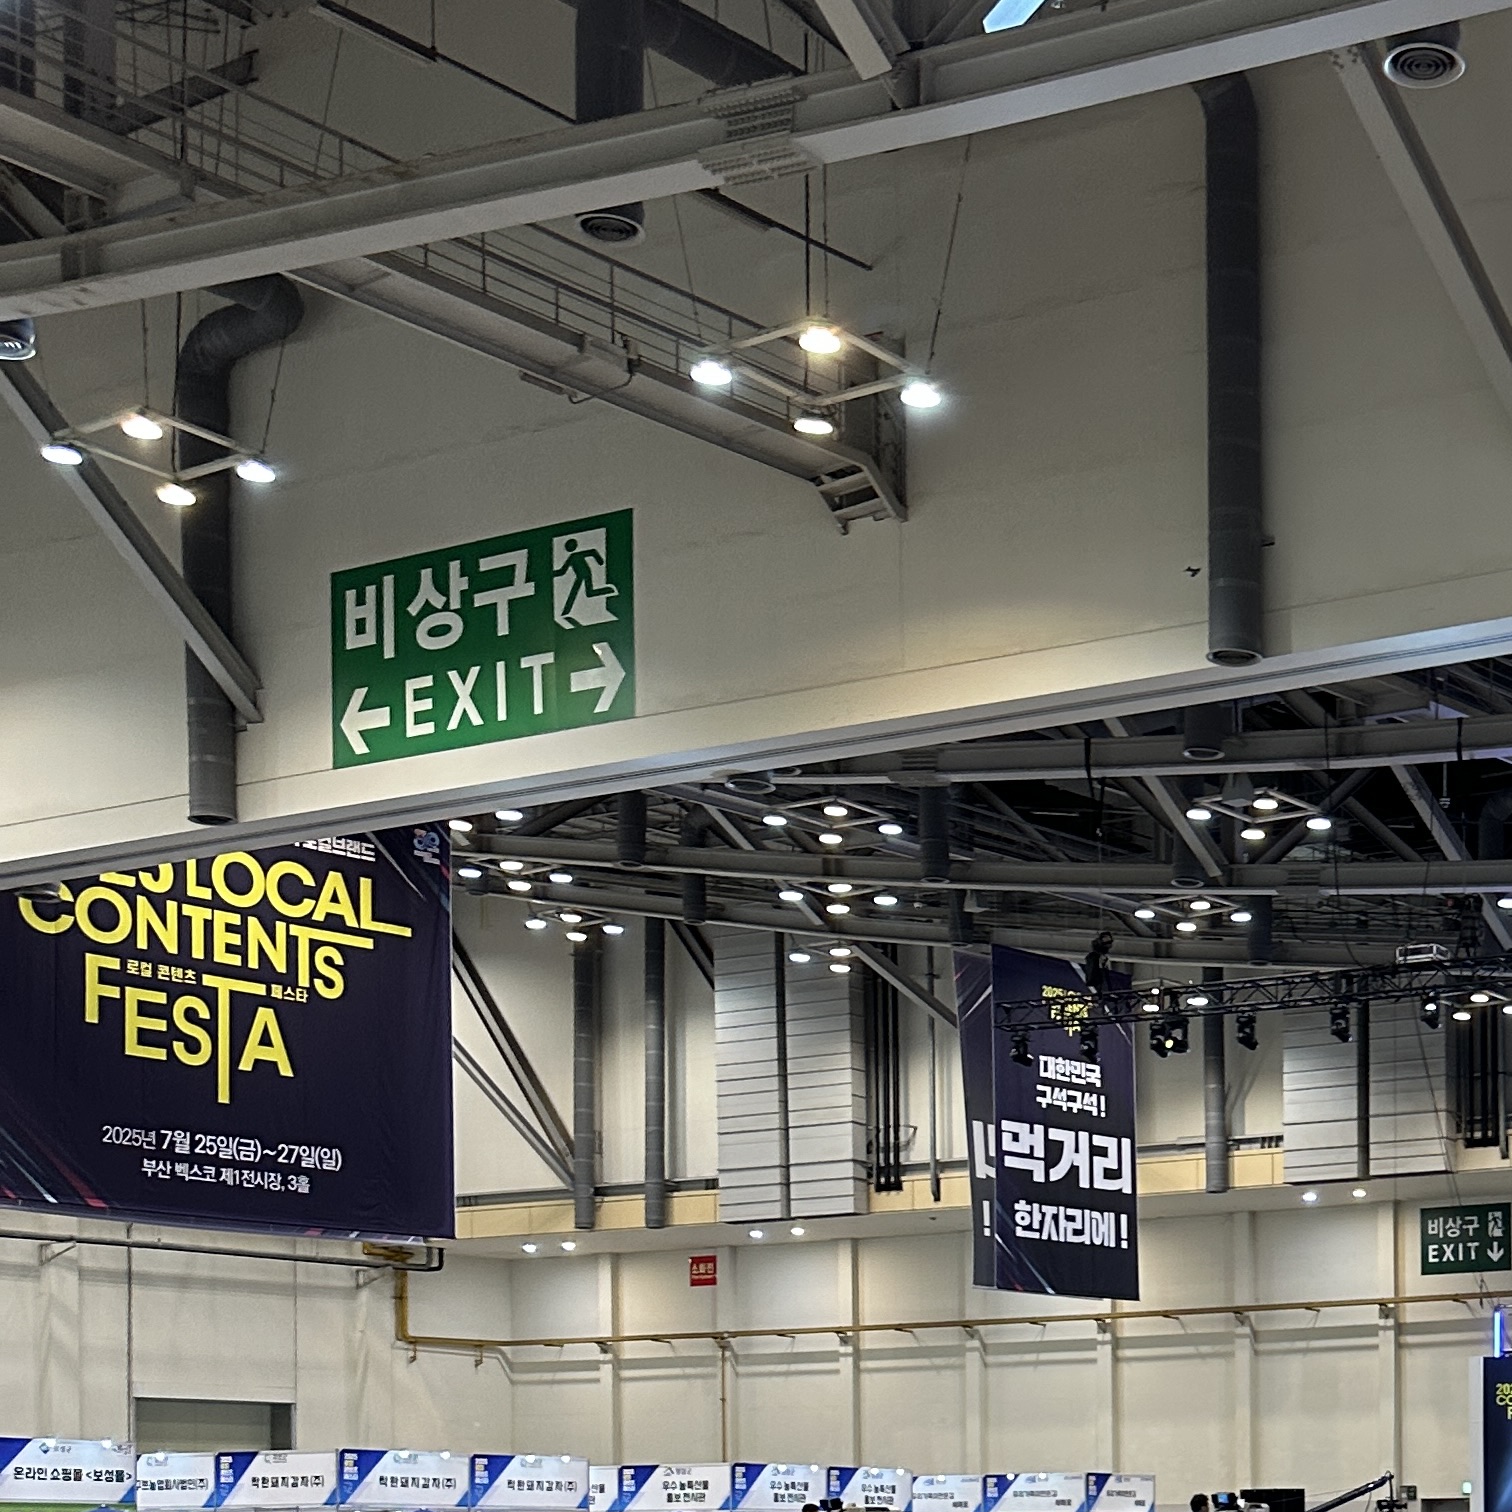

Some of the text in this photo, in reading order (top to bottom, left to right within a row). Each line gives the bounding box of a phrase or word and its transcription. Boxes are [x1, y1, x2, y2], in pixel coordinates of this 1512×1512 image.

[345, 549, 536, 659] 비상구
[405, 651, 555, 738] EXIT
[187, 850, 412, 937] LOCAL
[18, 882, 374, 999] CONTENTS
[126, 959, 152, 978] 로컬
[157, 964, 197, 985] 콘텐츠
[85, 953, 294, 1104] FESTA
[1038, 1054, 1102, 1088] 대한민국
[1035, 1083, 1106, 1118] 구석구석!
[102, 1126, 156, 1150] 2025년
[160, 1130, 191, 1155] 7월
[1000, 1119, 1132, 1195] 먹거리
[141, 1158, 172, 1179] 부산
[174, 1162, 217, 1182] 벡스코
[219, 1167, 285, 1192] 제1전시장,
[1013, 1198, 1129, 1250] 한자리에!
[1427, 1215, 1480, 1239] 비상구
[1427, 1241, 1480, 1264] EXIT
[13, 1466, 48, 1481] 온라인
